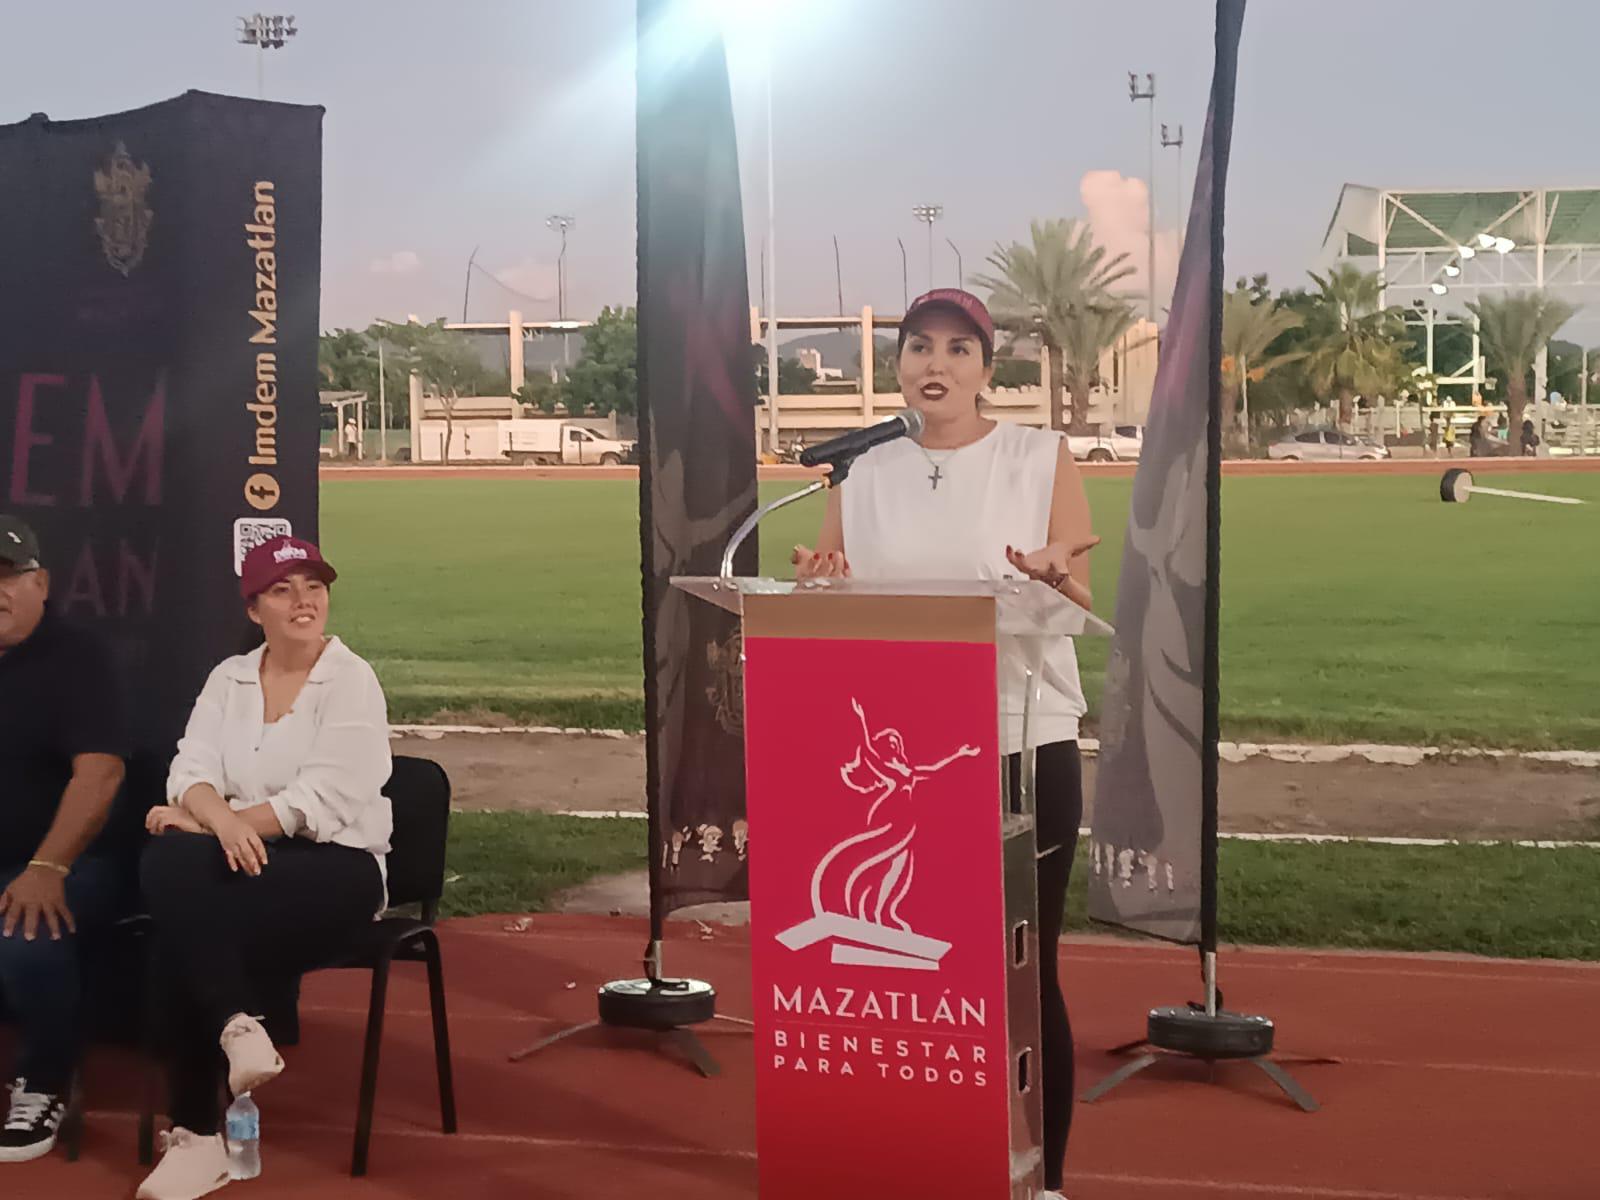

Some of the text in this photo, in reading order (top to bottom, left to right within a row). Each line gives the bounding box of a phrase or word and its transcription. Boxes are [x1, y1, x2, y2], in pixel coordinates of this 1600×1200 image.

[245, 180, 278, 343] Mazatlan
[246, 351, 278, 464] Imdem
[772, 983, 987, 1027] MAZATLÁN
[774, 1030, 987, 1064] BIENESTAR
[773, 1054, 987, 1087] PARA TODOS
